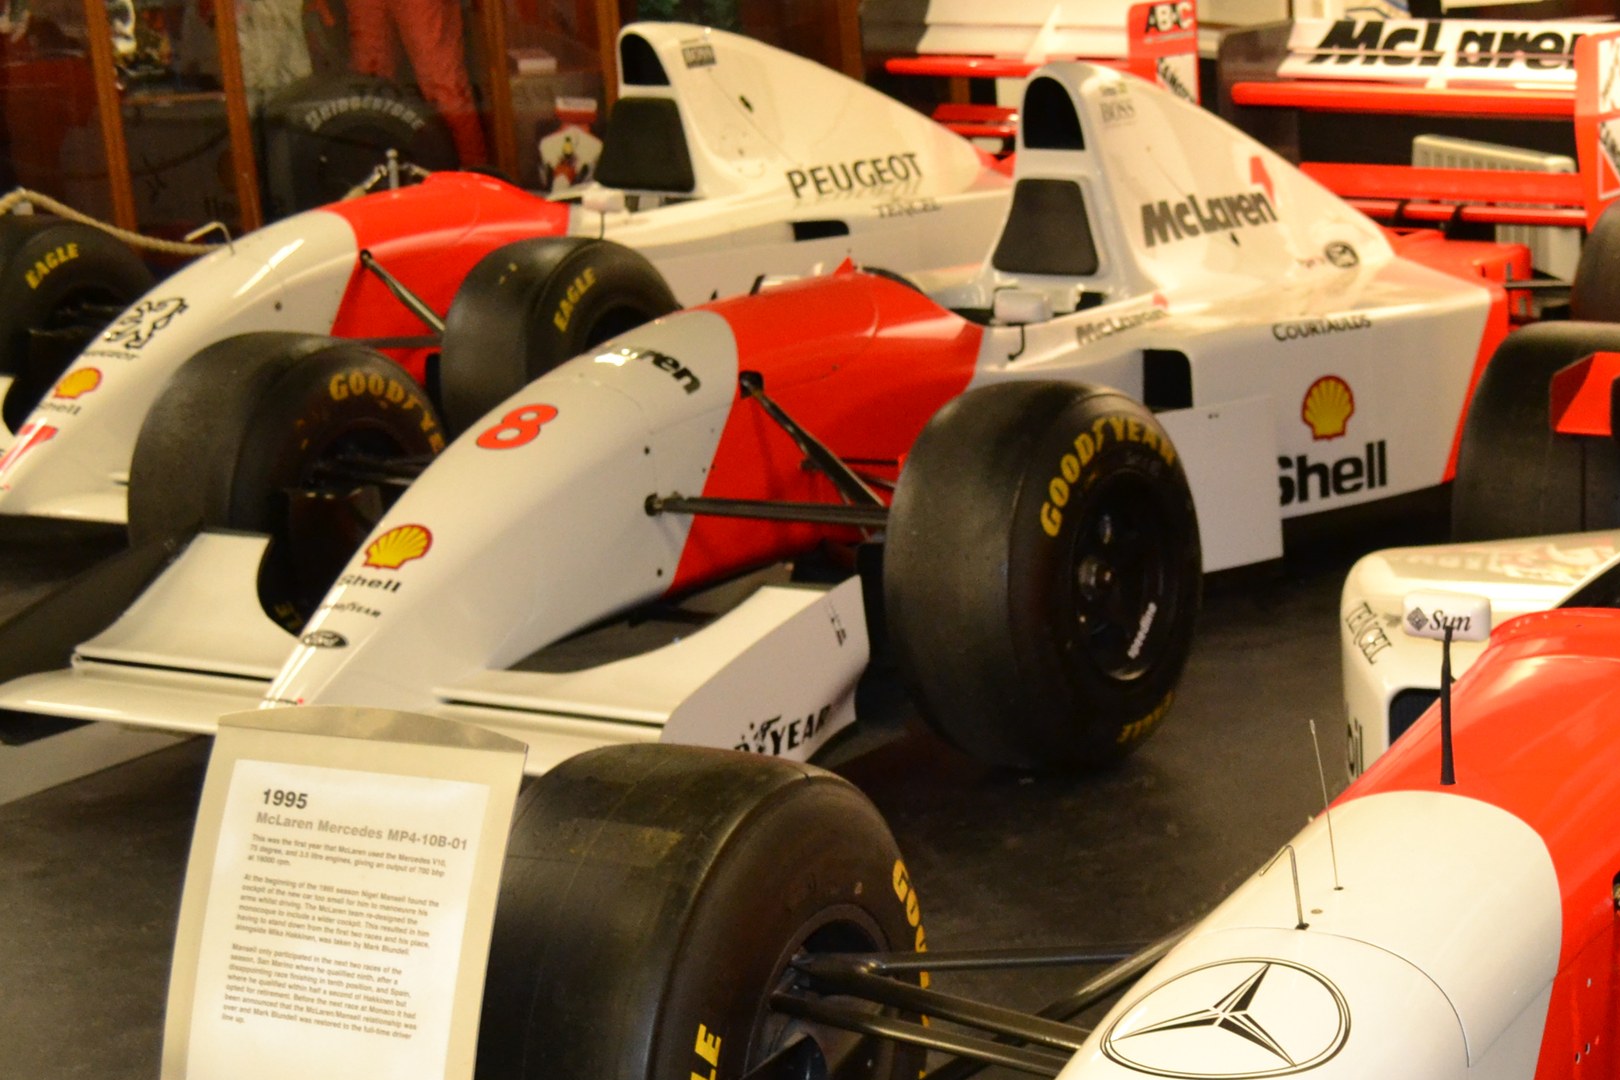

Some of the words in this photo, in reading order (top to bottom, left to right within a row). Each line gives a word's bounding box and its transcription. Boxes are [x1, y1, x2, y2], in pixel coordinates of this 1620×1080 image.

[1307, 20, 1576, 71] McLare
[786, 152, 923, 199] PEUGEOT
[1141, 192, 1278, 248] McLaren
[25, 242, 79, 290] EAGLE
[553, 267, 597, 333] EAGLE
[476, 403, 560, 450] 8
[1040, 416, 1175, 538] GOODYEAR
[1429, 610, 1472, 632] Sun
[262, 788, 308, 809] 1995
[255, 811, 313, 829] McLaren
[317, 819, 383, 839] Mercedes
[386, 828, 467, 850] MP4-10B-01
